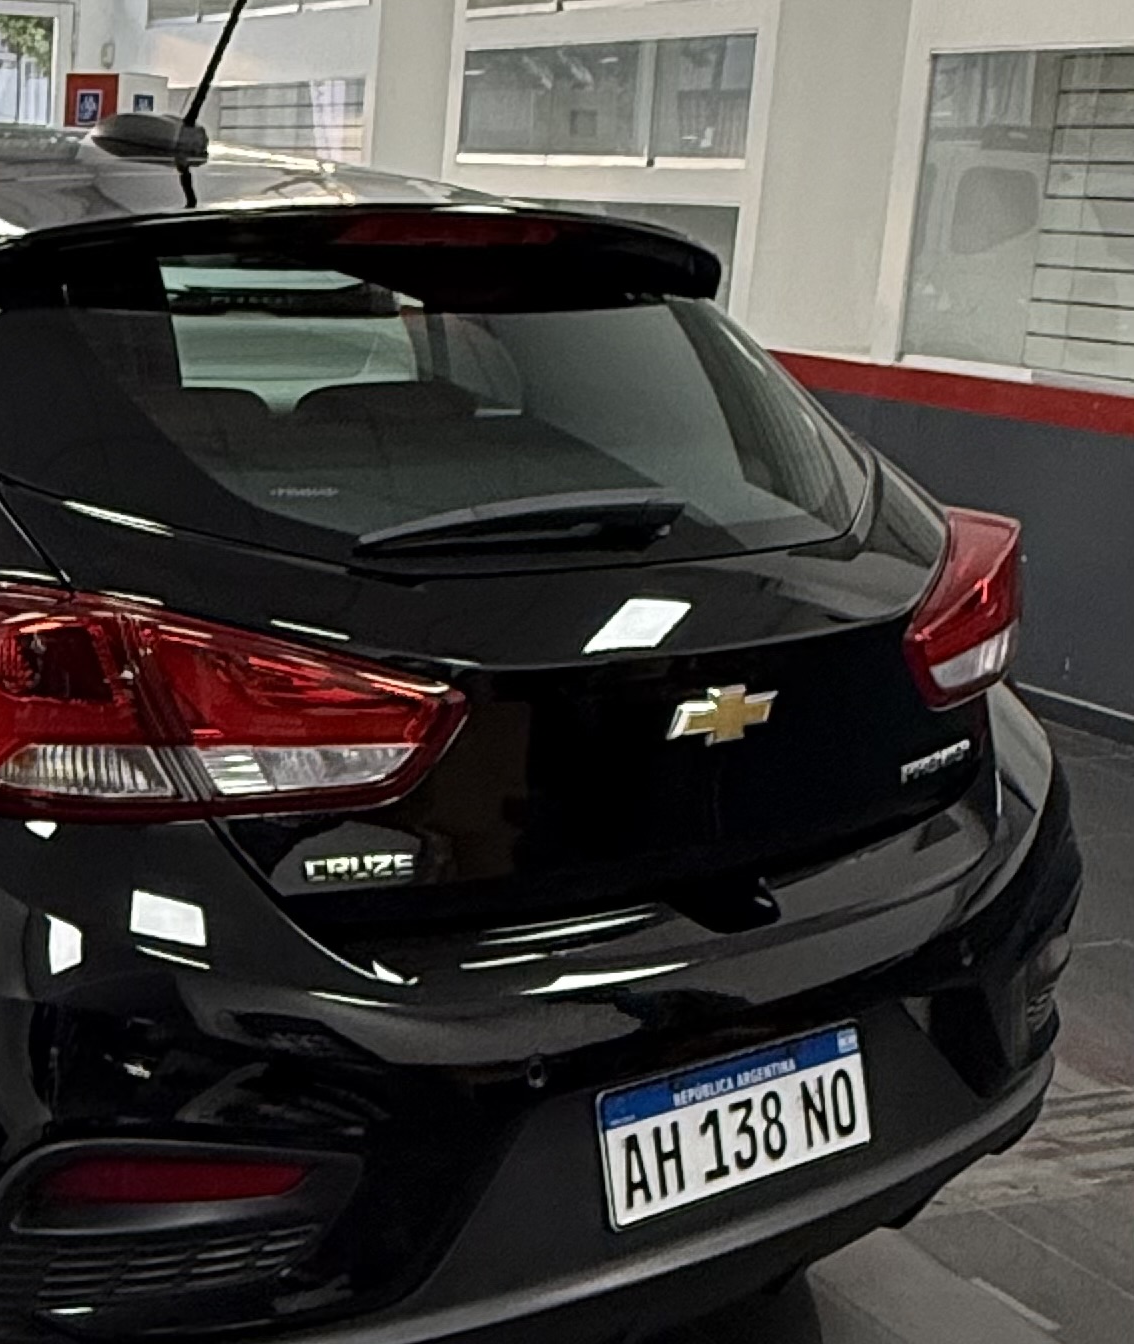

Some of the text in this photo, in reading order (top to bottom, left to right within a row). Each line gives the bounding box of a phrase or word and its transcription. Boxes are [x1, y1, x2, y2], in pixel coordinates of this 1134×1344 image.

[304, 854, 414, 882] CRUZE
[736, 1058, 796, 1089] ARGENTINA
[624, 1068, 857, 1210] AH 138 NO
